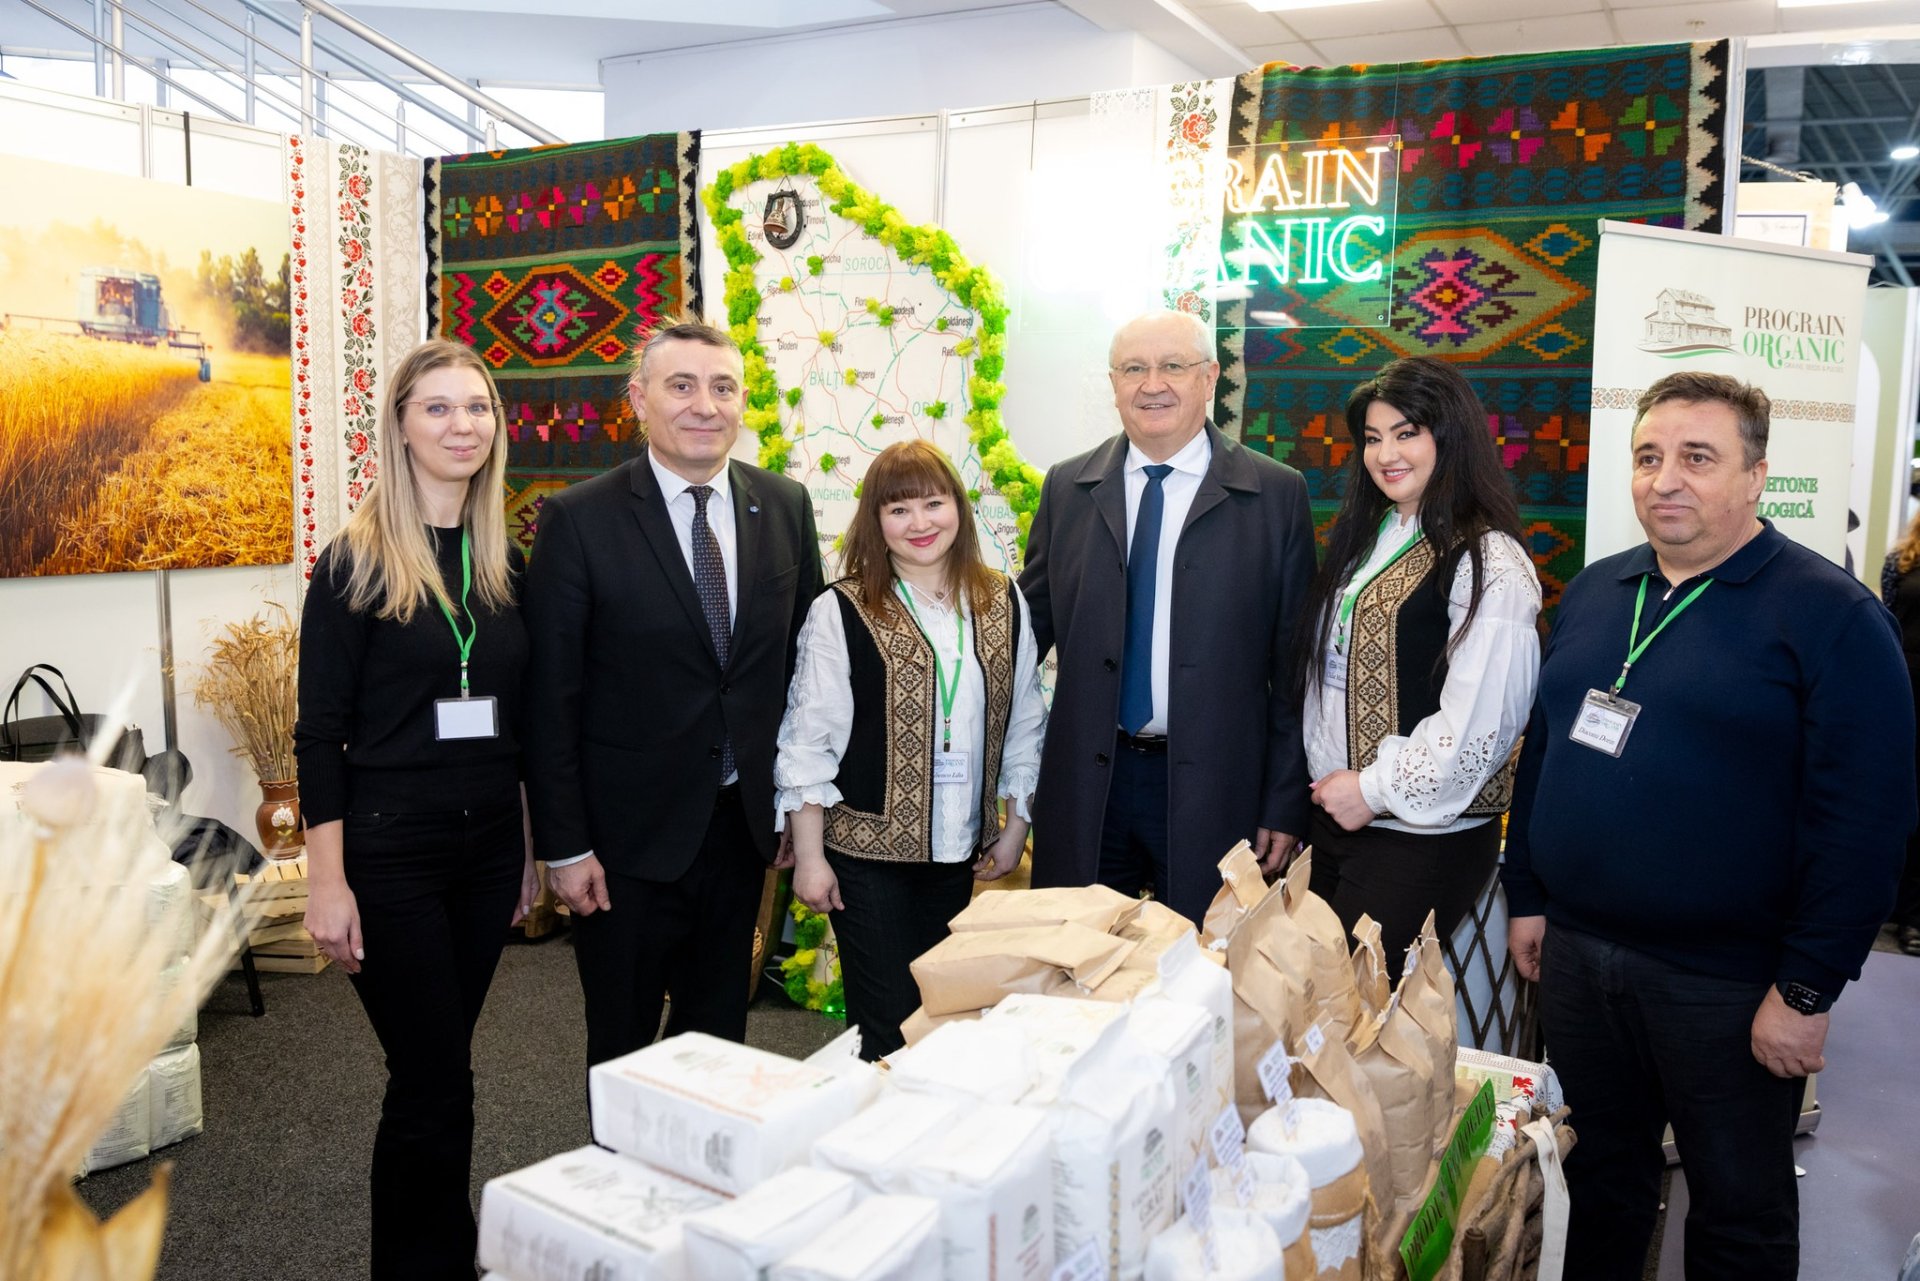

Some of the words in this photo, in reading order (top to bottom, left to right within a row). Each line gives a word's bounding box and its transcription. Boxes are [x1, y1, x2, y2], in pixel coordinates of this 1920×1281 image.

[1224, 146, 1390, 214] RAIN
[845, 256, 890, 271] SOROCA
[1744, 306, 1845, 337] PROGRAIN
[1743, 331, 1845, 369] ORGANIC
[1765, 476, 1818, 493] HTONE
[1757, 500, 1815, 518] LOGICĂ
